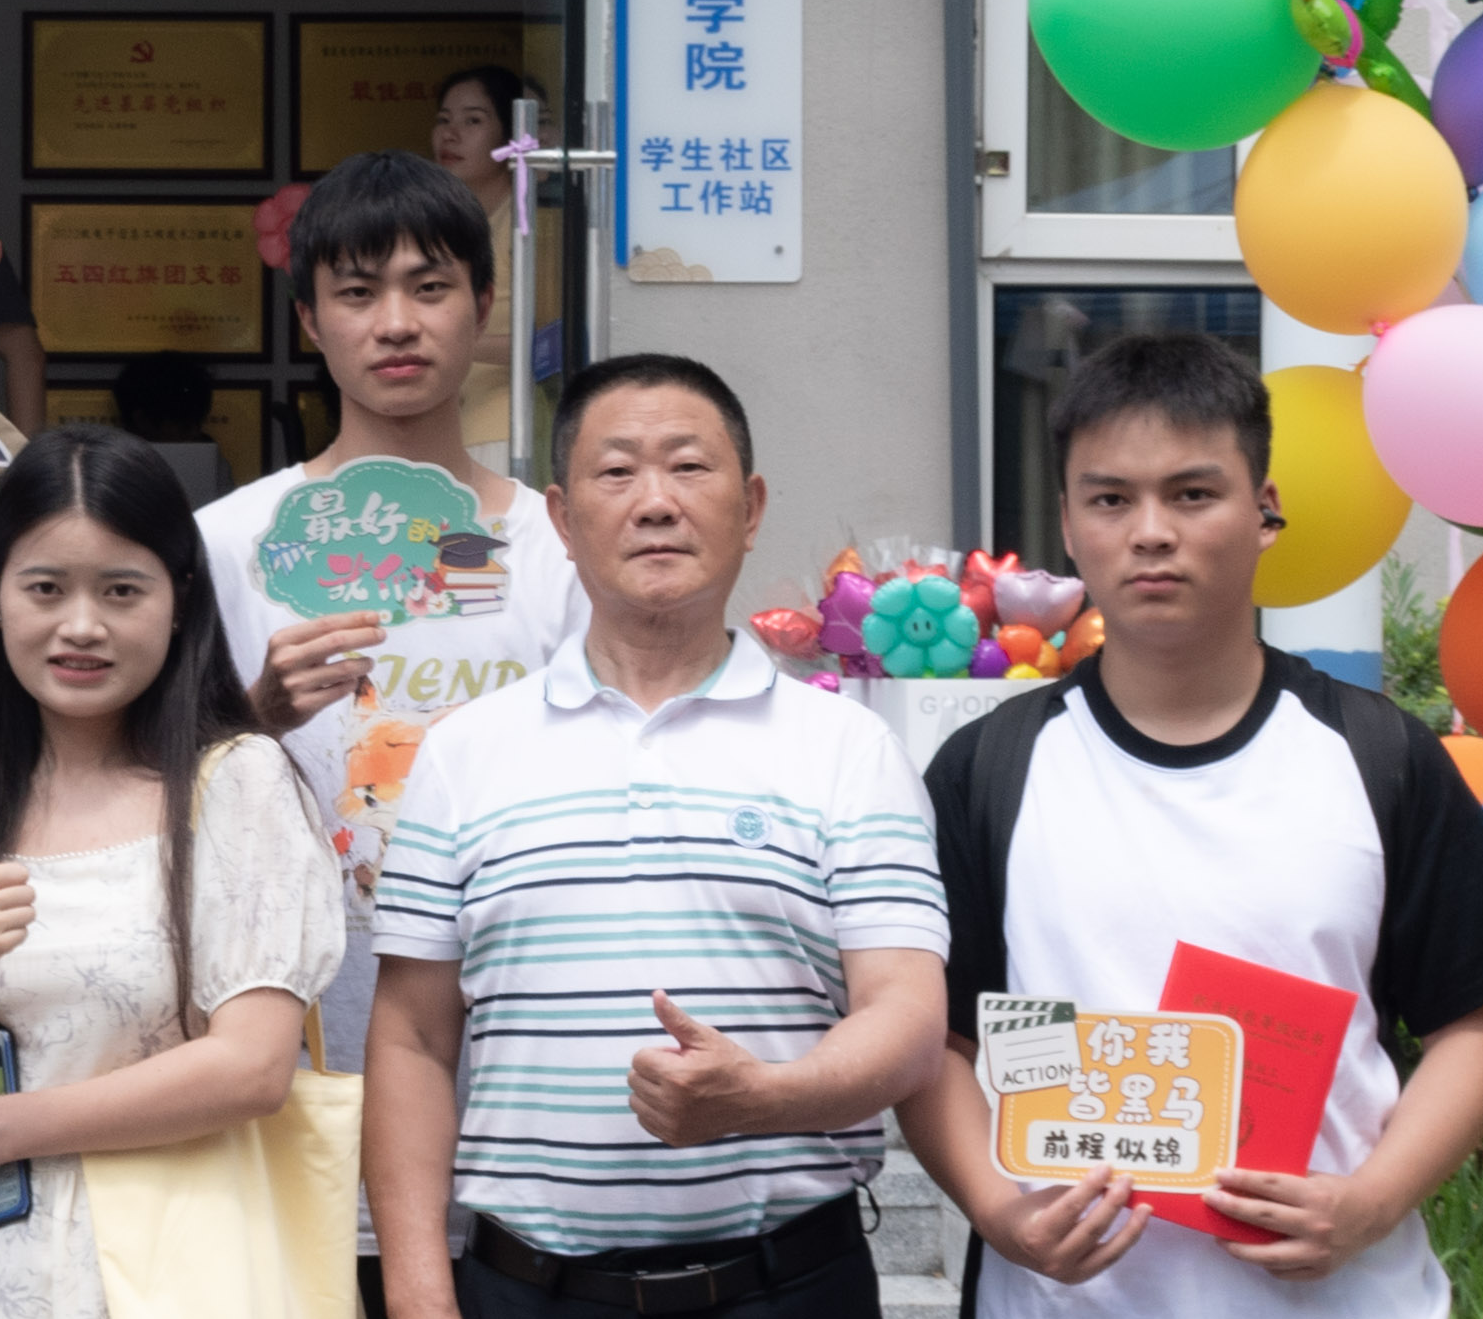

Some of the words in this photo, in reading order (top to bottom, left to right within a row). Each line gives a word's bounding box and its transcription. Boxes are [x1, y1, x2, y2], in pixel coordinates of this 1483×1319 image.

[640, 137, 794, 173] 学生社区
[659, 182, 775, 216] 工作站
[54, 265, 242, 285] 五四红旗团支部
[300, 489, 441, 545] 最好的
[317, 552, 427, 603] 我们
[919, 695, 1001, 716] GOD
[1087, 1018, 1192, 1069] 你我
[1002, 1062, 1076, 1087] ACTION
[1067, 1068, 1205, 1131] 皆黑马
[1042, 1129, 1181, 1166] 前程似锦
